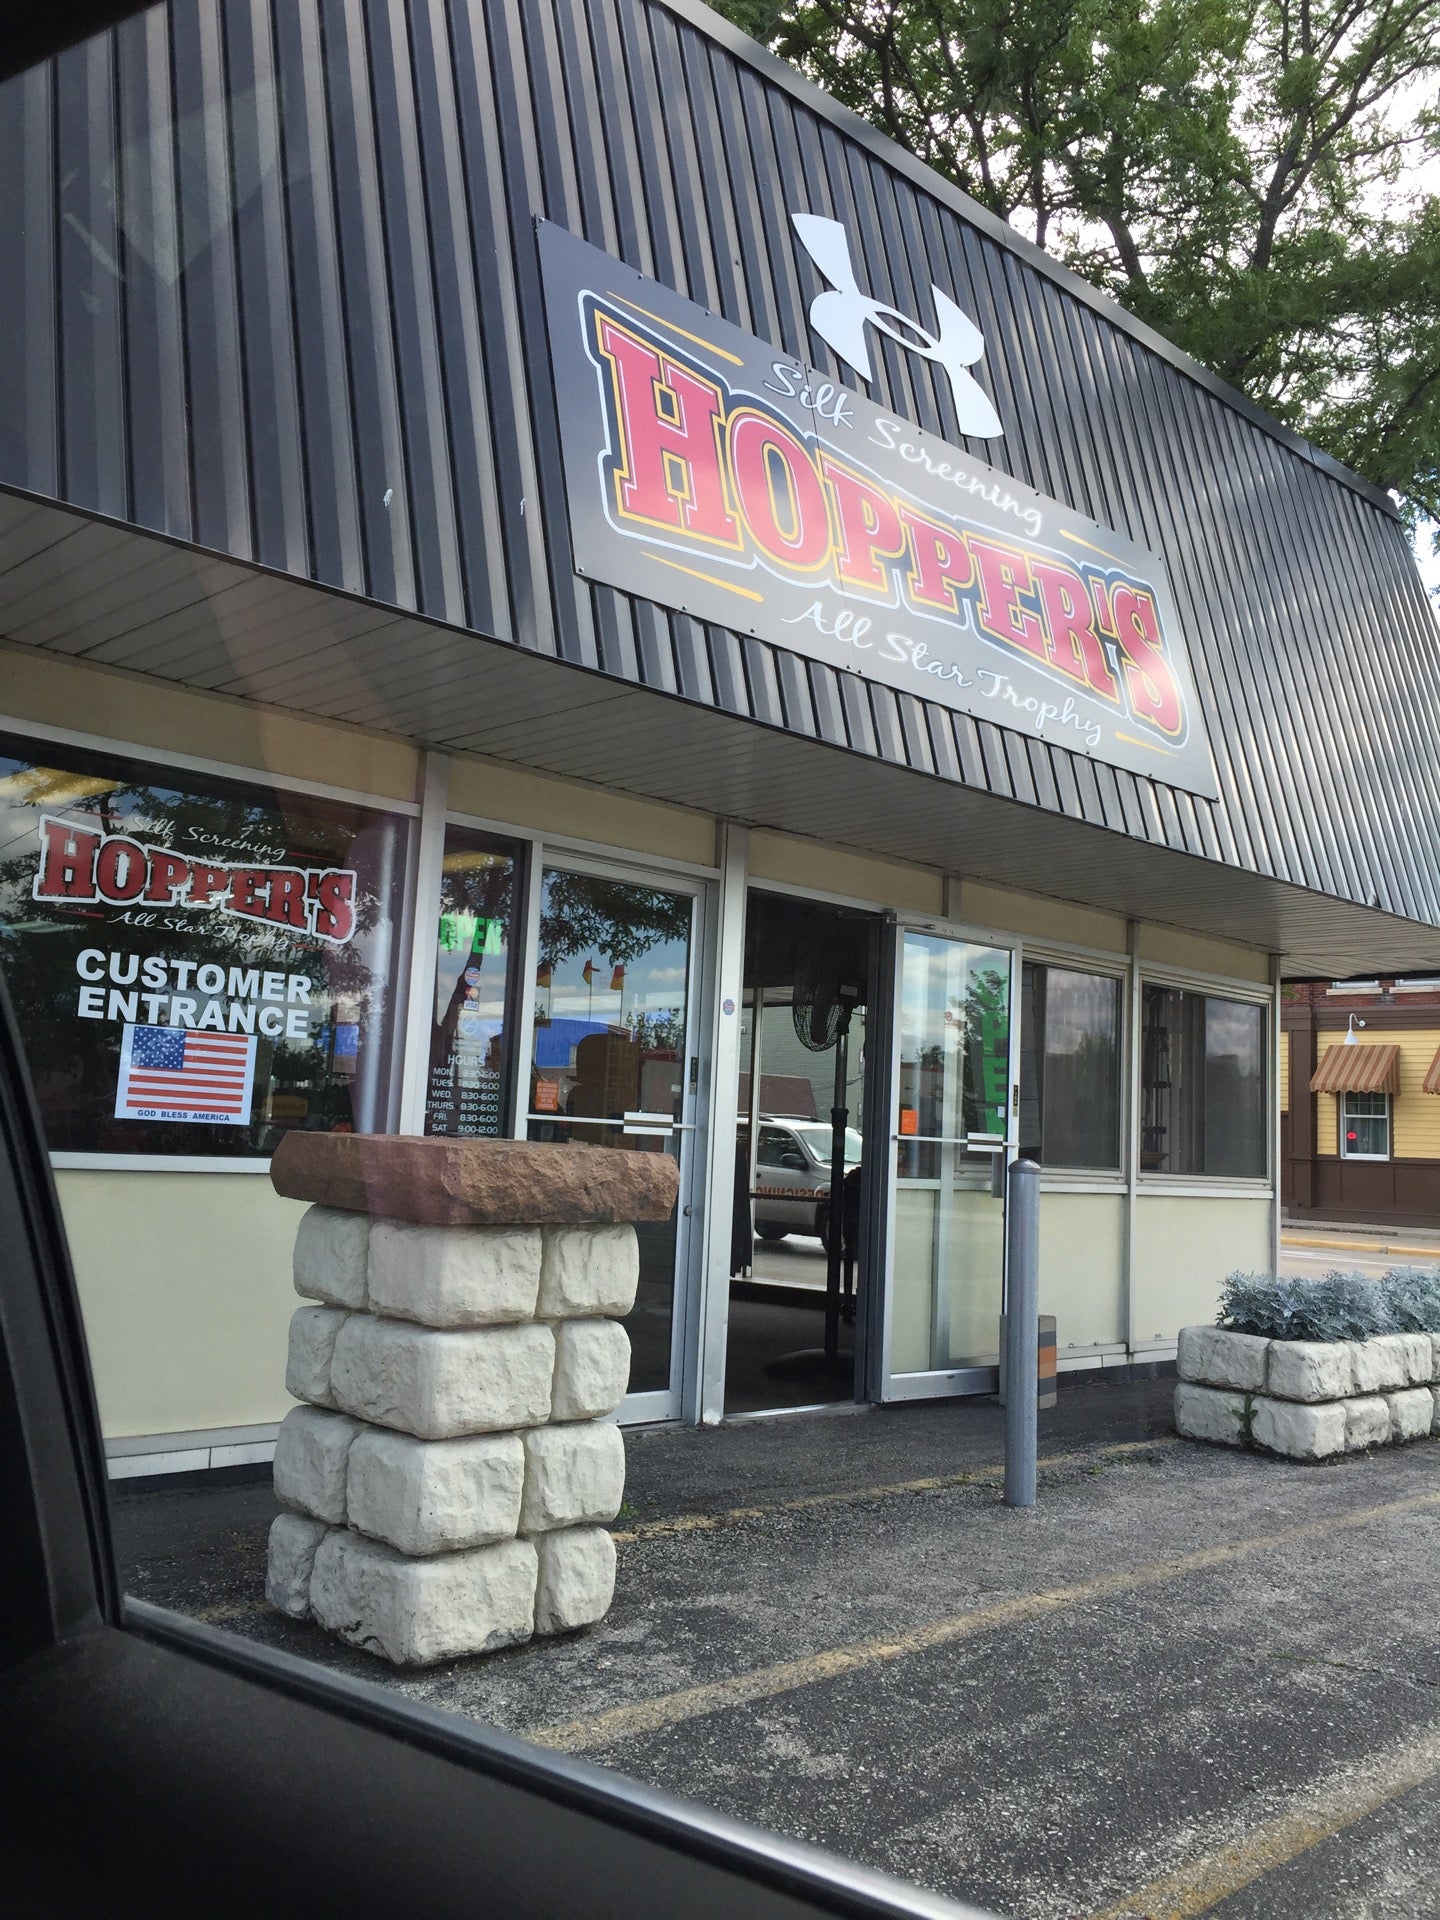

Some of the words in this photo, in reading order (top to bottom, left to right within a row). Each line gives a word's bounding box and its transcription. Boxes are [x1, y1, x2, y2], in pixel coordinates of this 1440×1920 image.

[763, 360, 855, 429] Silk
[867, 418, 1043, 537] Screening
[590, 303, 1186, 743] HOPPER'S
[780, 602, 873, 648] All
[879, 631, 973, 689] Star
[976, 671, 1102, 746] Trophy
[128, 816, 176, 837] Silk
[182, 826, 286, 861] Screening
[35, 817, 356, 942] HOPPER'S
[107, 911, 157, 927] All
[157, 918, 210, 935] Star
[214, 925, 290, 950] Trophy
[439, 913, 502, 956] OPEN
[75, 948, 312, 1005] CUSTOMER
[77, 985, 310, 1039] ENTRANCE
[447, 1054, 486, 1067] HOURS
[137, 1109, 157, 1117] GOD
[160, 1110, 188, 1119] BLESS
[192, 1112, 230, 1122] AMERICA
